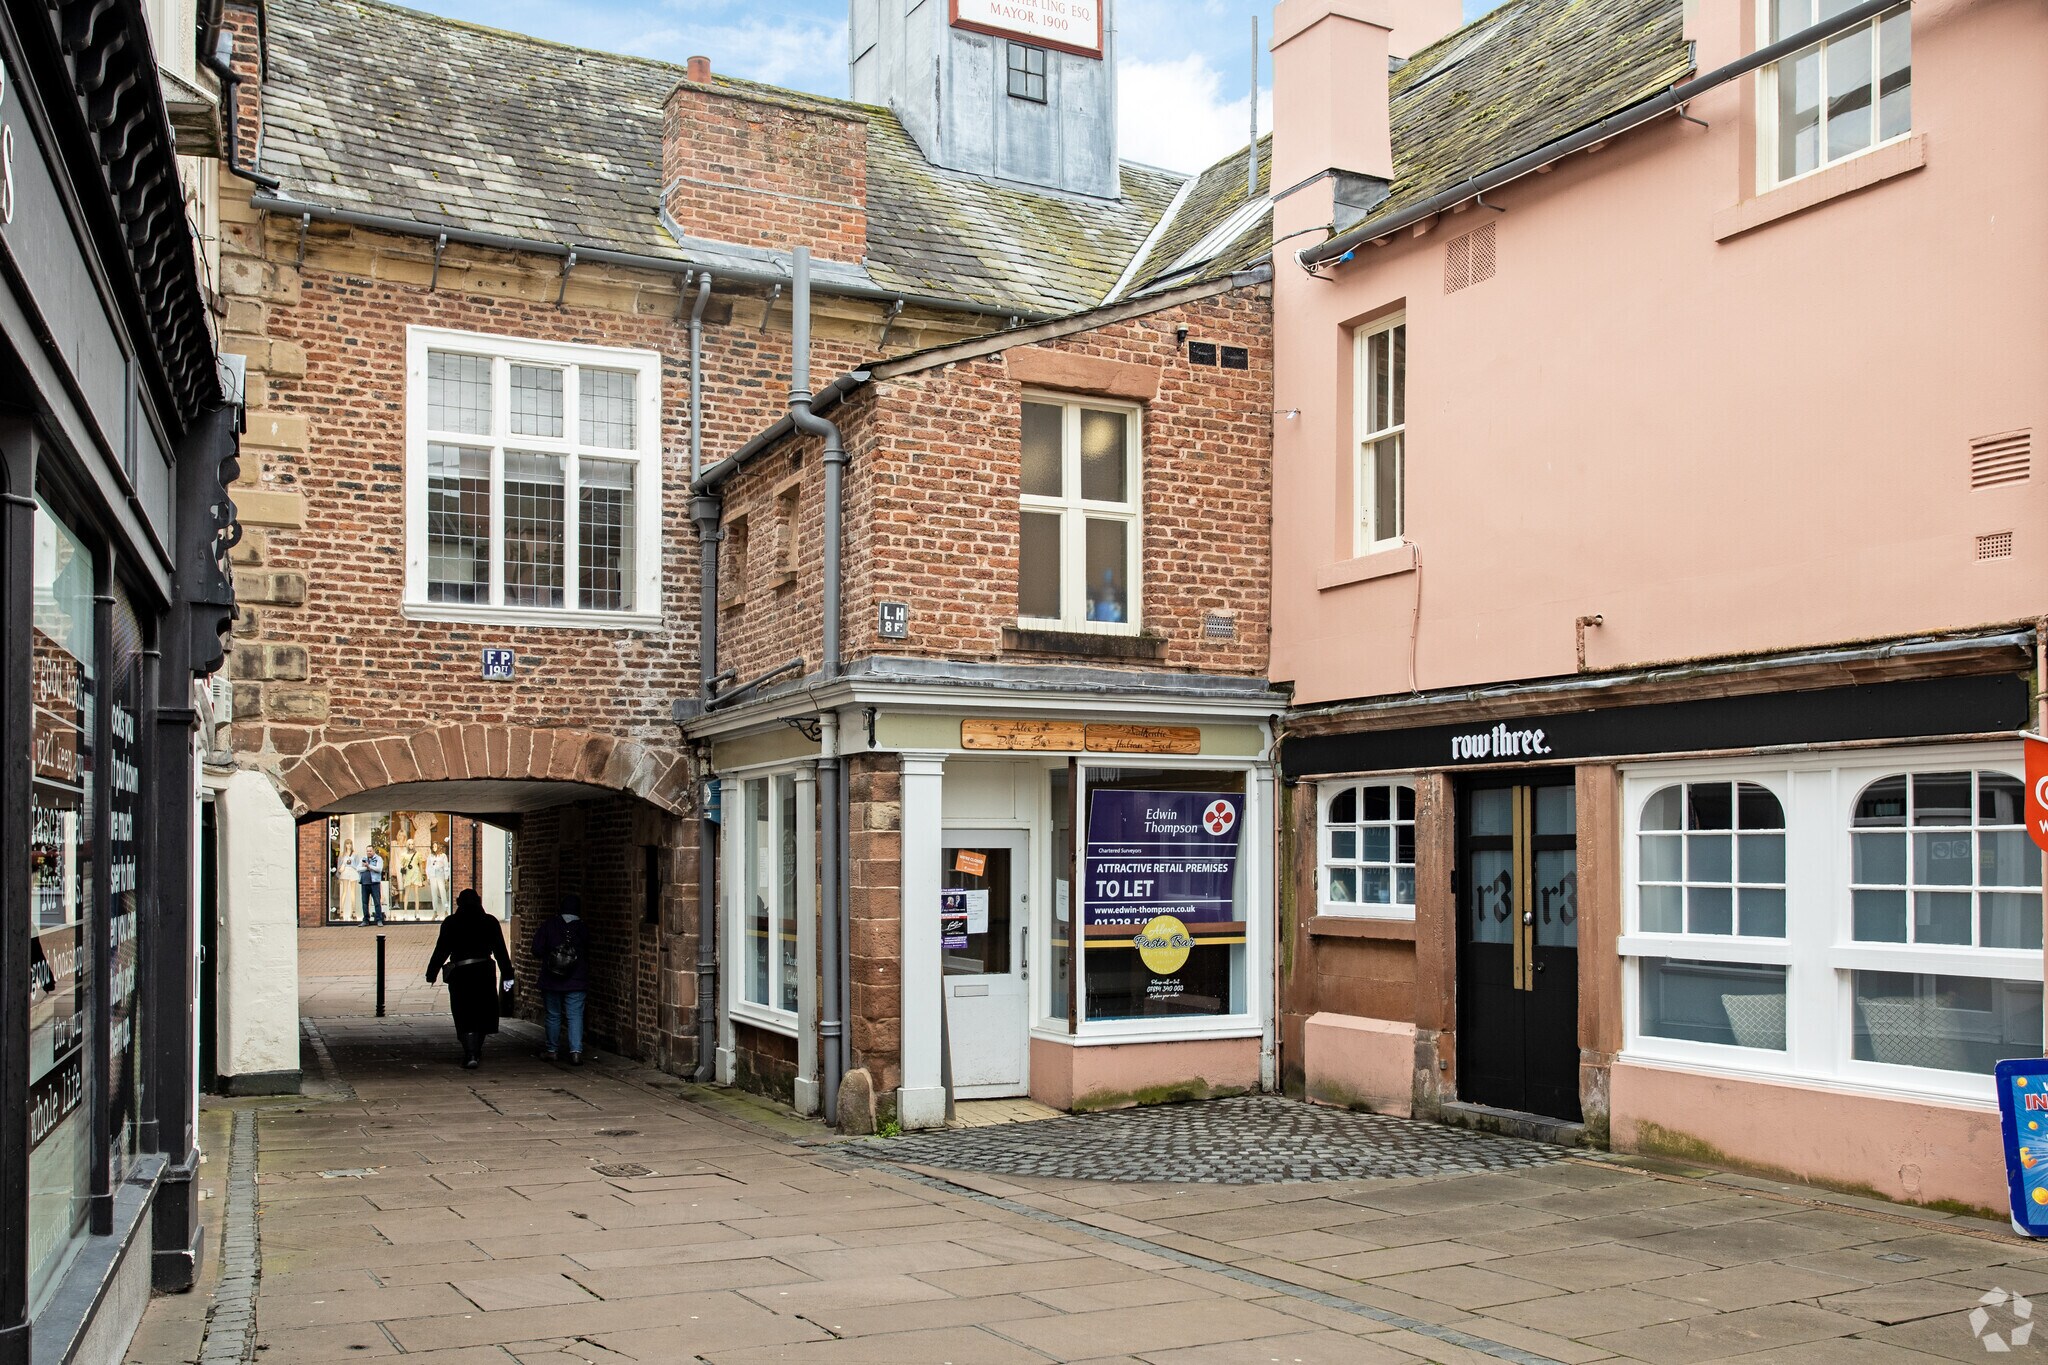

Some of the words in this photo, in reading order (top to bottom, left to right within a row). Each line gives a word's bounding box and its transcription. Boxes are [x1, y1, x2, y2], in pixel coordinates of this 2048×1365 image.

[1043, 14, 1068, 30] 1900
[40, 656, 62, 702] good
[66, 662, 84, 711] book
[36, 731, 54, 768] will
[57, 736, 72, 780] keep
[1144, 821, 1198, 837] Thompson
[1146, 808, 1177, 820] Edwin
[1096, 864, 1152, 873] ATTRACTIVE
[1154, 864, 1184, 872] RETAIL
[1185, 864, 1228, 872] PREMISES
[42, 864, 58, 911] for
[1096, 880, 1120, 898] TO
[1124, 880, 1154, 897] LET
[1477, 869, 1512, 924] r3
[1542, 870, 1578, 926] r3
[1094, 905, 1195, 914] www.edwin-thompson.co.uk
[1133, 934, 1168, 950] Pasta
[1170, 932, 1196, 949] Bar
[31, 948, 50, 1000] good
[53, 942, 83, 982] bookshop
[54, 1016, 67, 1051] for
[31, 1084, 58, 1146] whole
[62, 1063, 82, 1115] life.
